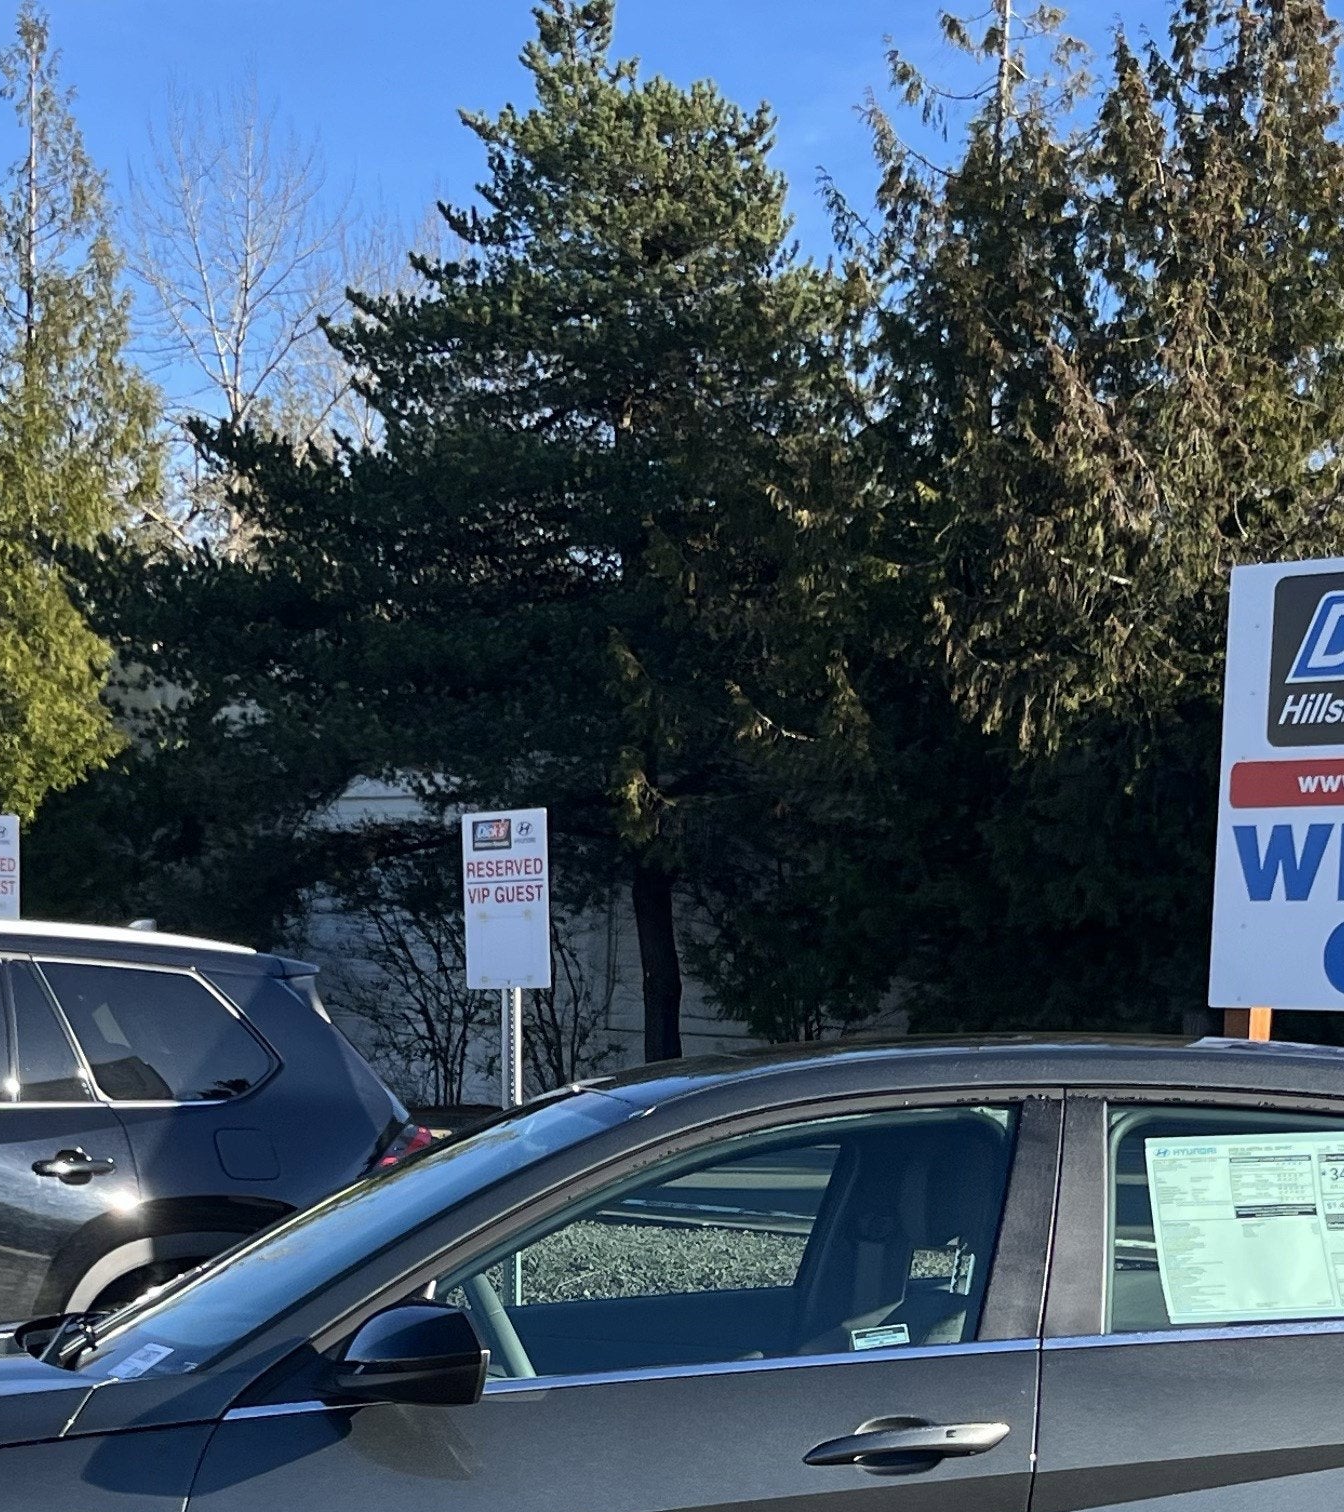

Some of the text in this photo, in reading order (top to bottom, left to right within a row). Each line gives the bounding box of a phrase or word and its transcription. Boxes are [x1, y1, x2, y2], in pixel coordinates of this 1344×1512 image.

[465, 857, 544, 879] RESERVED
[467, 884, 544, 905] VIP GUEST
